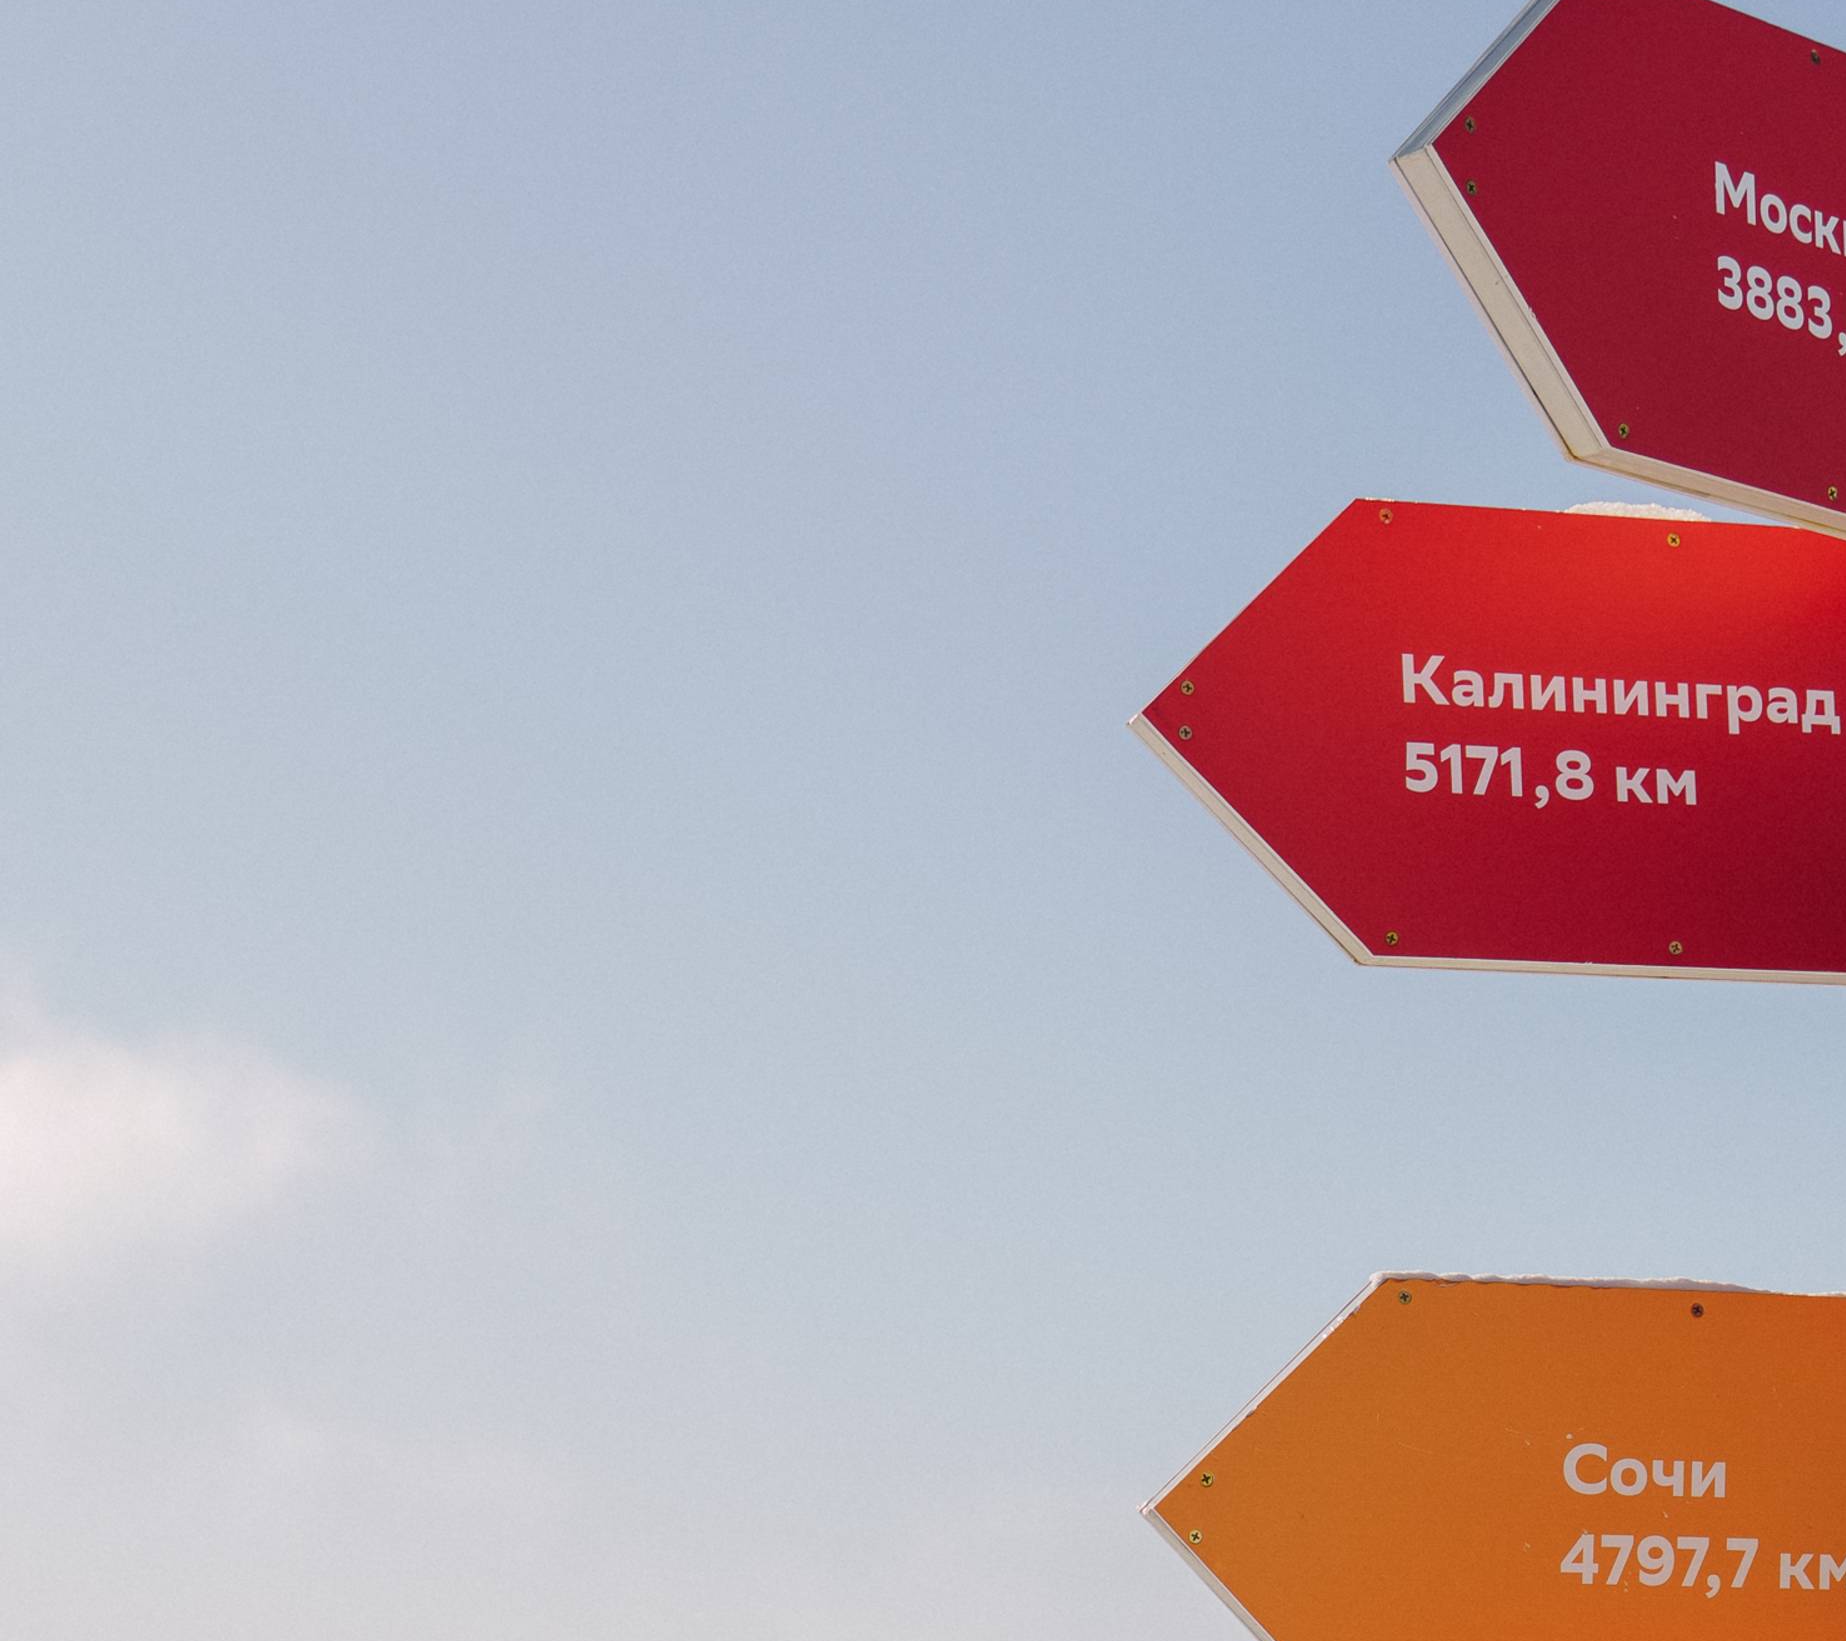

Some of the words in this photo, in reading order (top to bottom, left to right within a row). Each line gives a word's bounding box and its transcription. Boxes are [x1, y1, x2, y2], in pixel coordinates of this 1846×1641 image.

[1400, 653, 1842, 735] Калининград
[1404, 741, 1595, 809] 5171,8
[1614, 764, 1699, 807] км
[1561, 1442, 1728, 1499] Сочи
[1559, 1533, 1759, 1599] 4797,7
